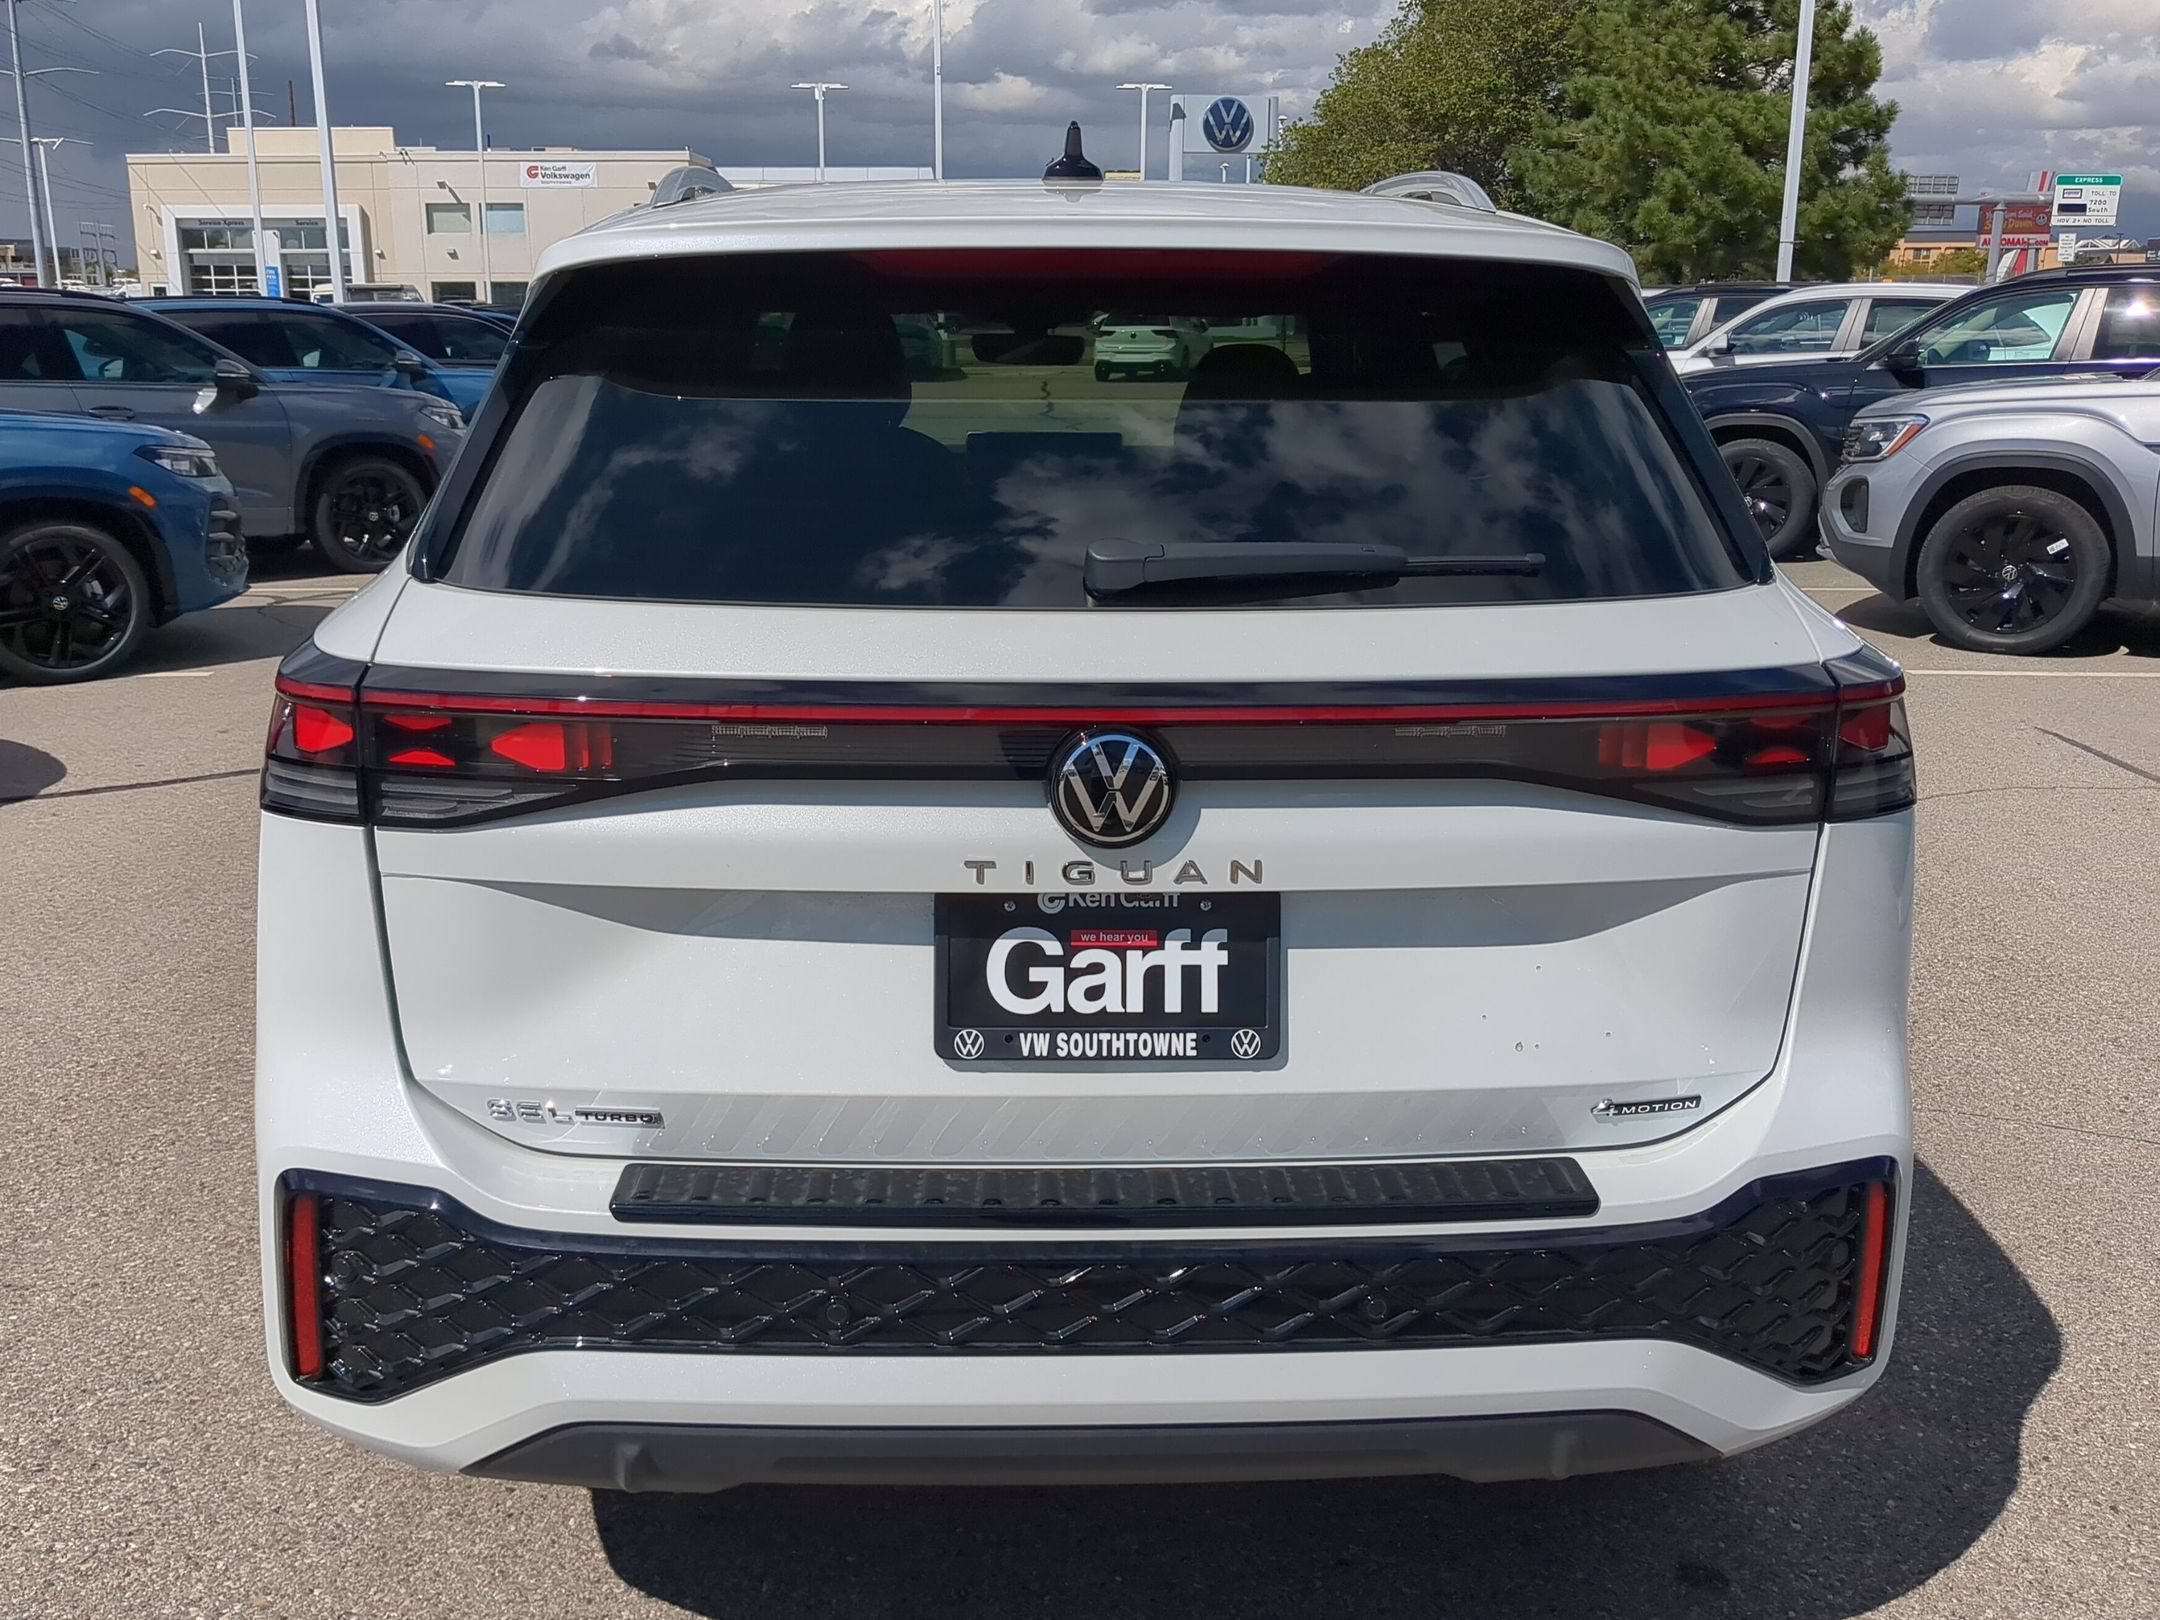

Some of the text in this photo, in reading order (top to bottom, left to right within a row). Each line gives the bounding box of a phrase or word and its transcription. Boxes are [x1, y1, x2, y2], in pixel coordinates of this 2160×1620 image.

[540, 172, 591, 180] Volkswagen
[964, 859, 1263, 886] TIGUAN
[1080, 931, 1149, 945] we hear you
[986, 926, 1229, 1015] Garff
[1019, 1032, 1198, 1057] VW SOUTHTOWNE
[1592, 1099, 1698, 1117] 4MOTION
[580, 1112, 655, 1124] TURBO
